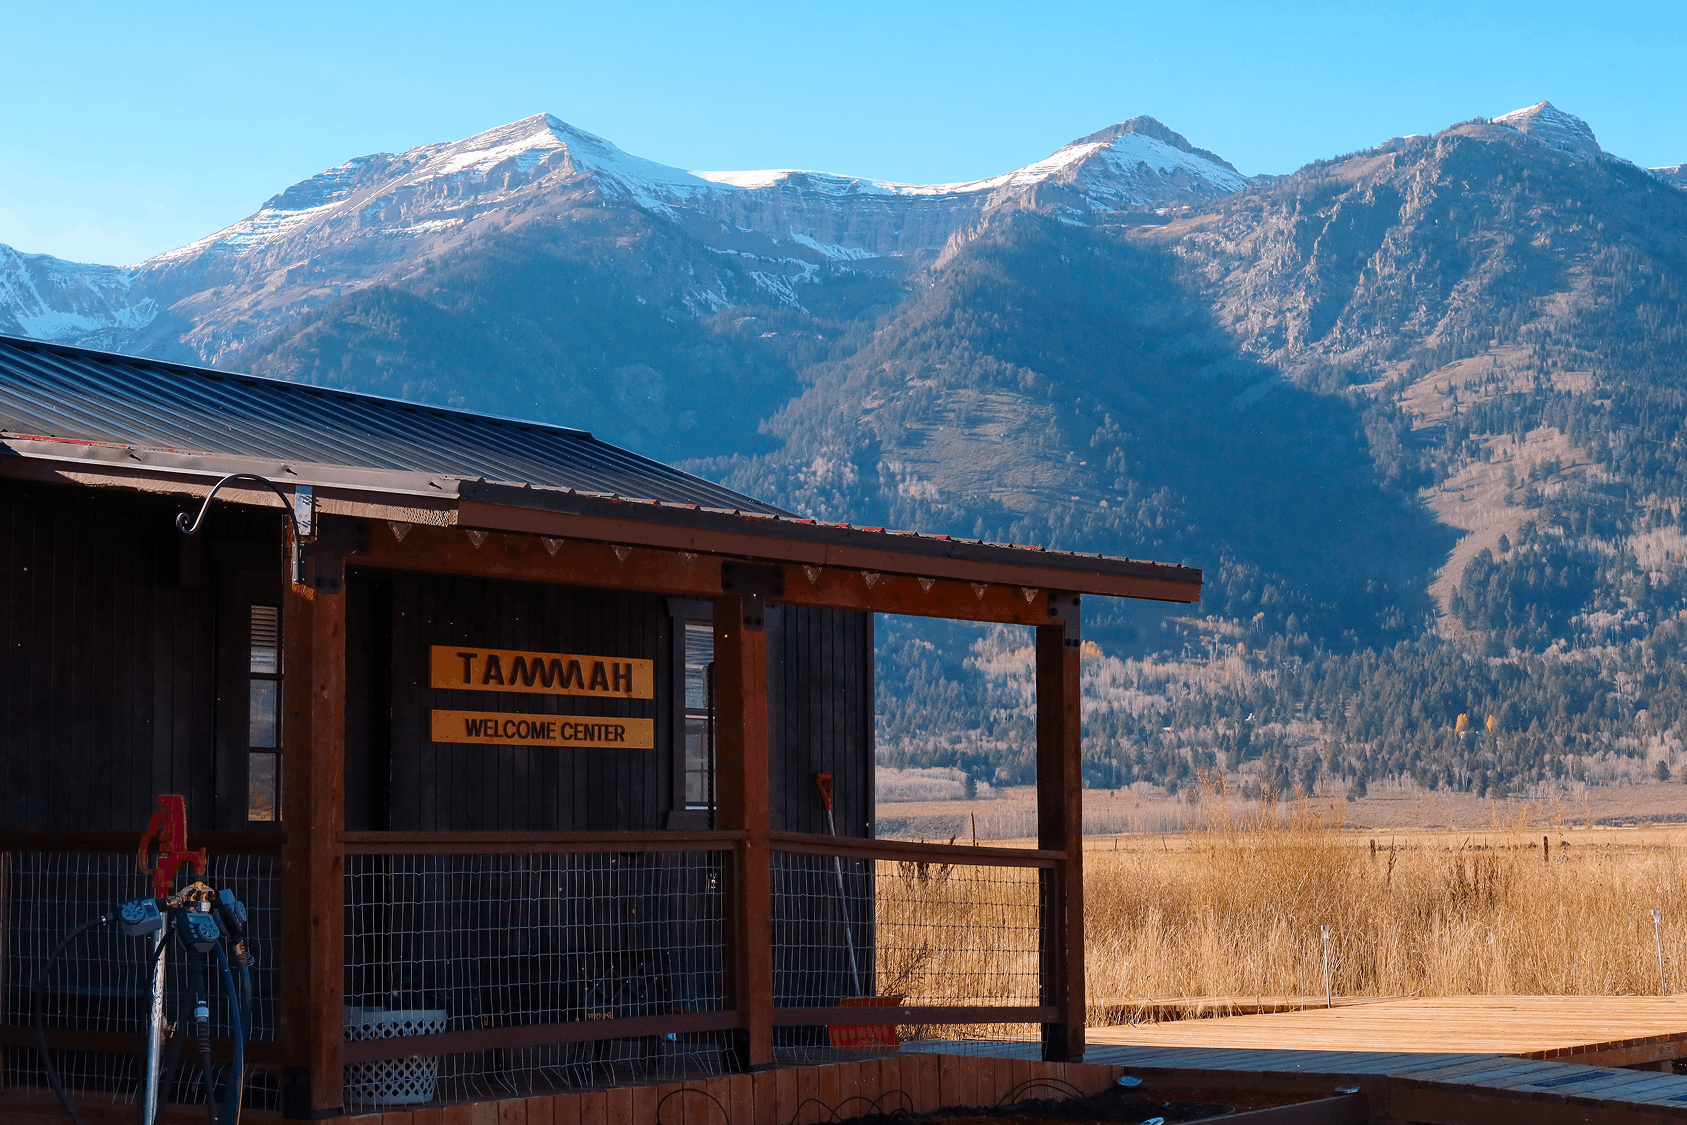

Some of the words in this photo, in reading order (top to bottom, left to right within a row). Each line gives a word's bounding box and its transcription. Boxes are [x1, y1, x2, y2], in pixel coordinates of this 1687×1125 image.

[456, 652, 633, 693] TAMMAH
[465, 718, 556, 740] WELCOME
[561, 723, 626, 743] CENTER
